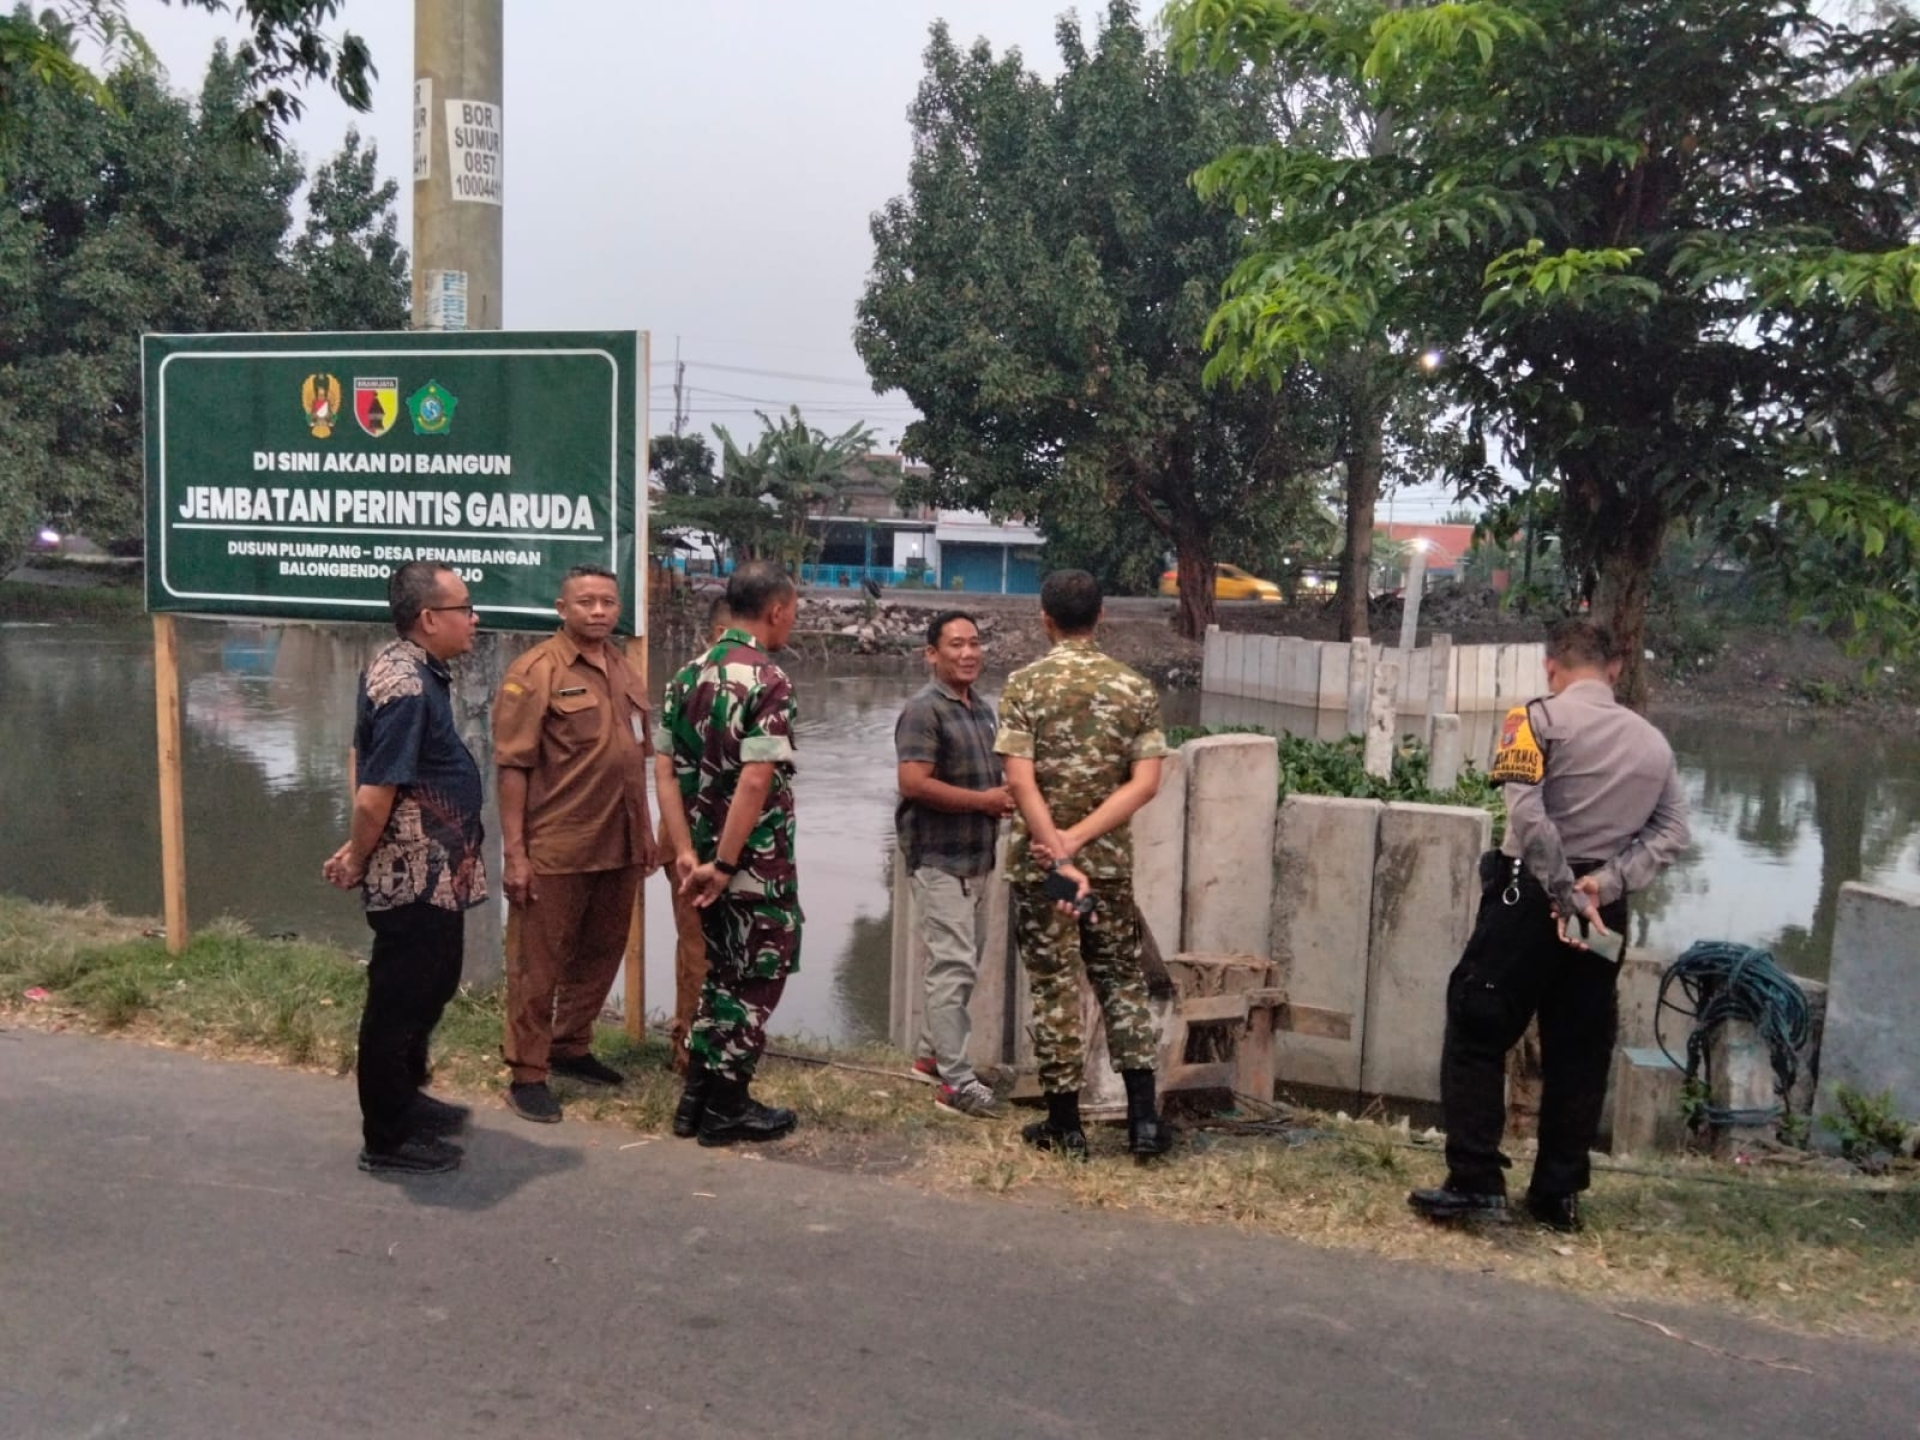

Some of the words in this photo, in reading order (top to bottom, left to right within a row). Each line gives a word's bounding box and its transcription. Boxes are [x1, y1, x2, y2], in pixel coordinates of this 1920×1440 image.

[462, 103, 493, 127] BOR
[455, 126, 499, 153] SUMUR
[464, 151, 496, 175] 0857
[253, 452, 275, 471] DI
[277, 452, 320, 472] SINI
[322, 453, 387, 473] AKAN
[389, 454, 412, 473] DI
[415, 454, 511, 475] BANGUN
[179, 486, 331, 523] JEMBATAN
[335, 489, 462, 526] PERINTIS
[465, 491, 595, 530] GARUDA
[228, 541, 278, 556] DUSUN
[279, 543, 361, 559] PLUMPANG
[373, 545, 414, 561] DESA
[416, 547, 541, 566] PENAMBANGAN
[279, 561, 391, 579] BALONGBENDO
